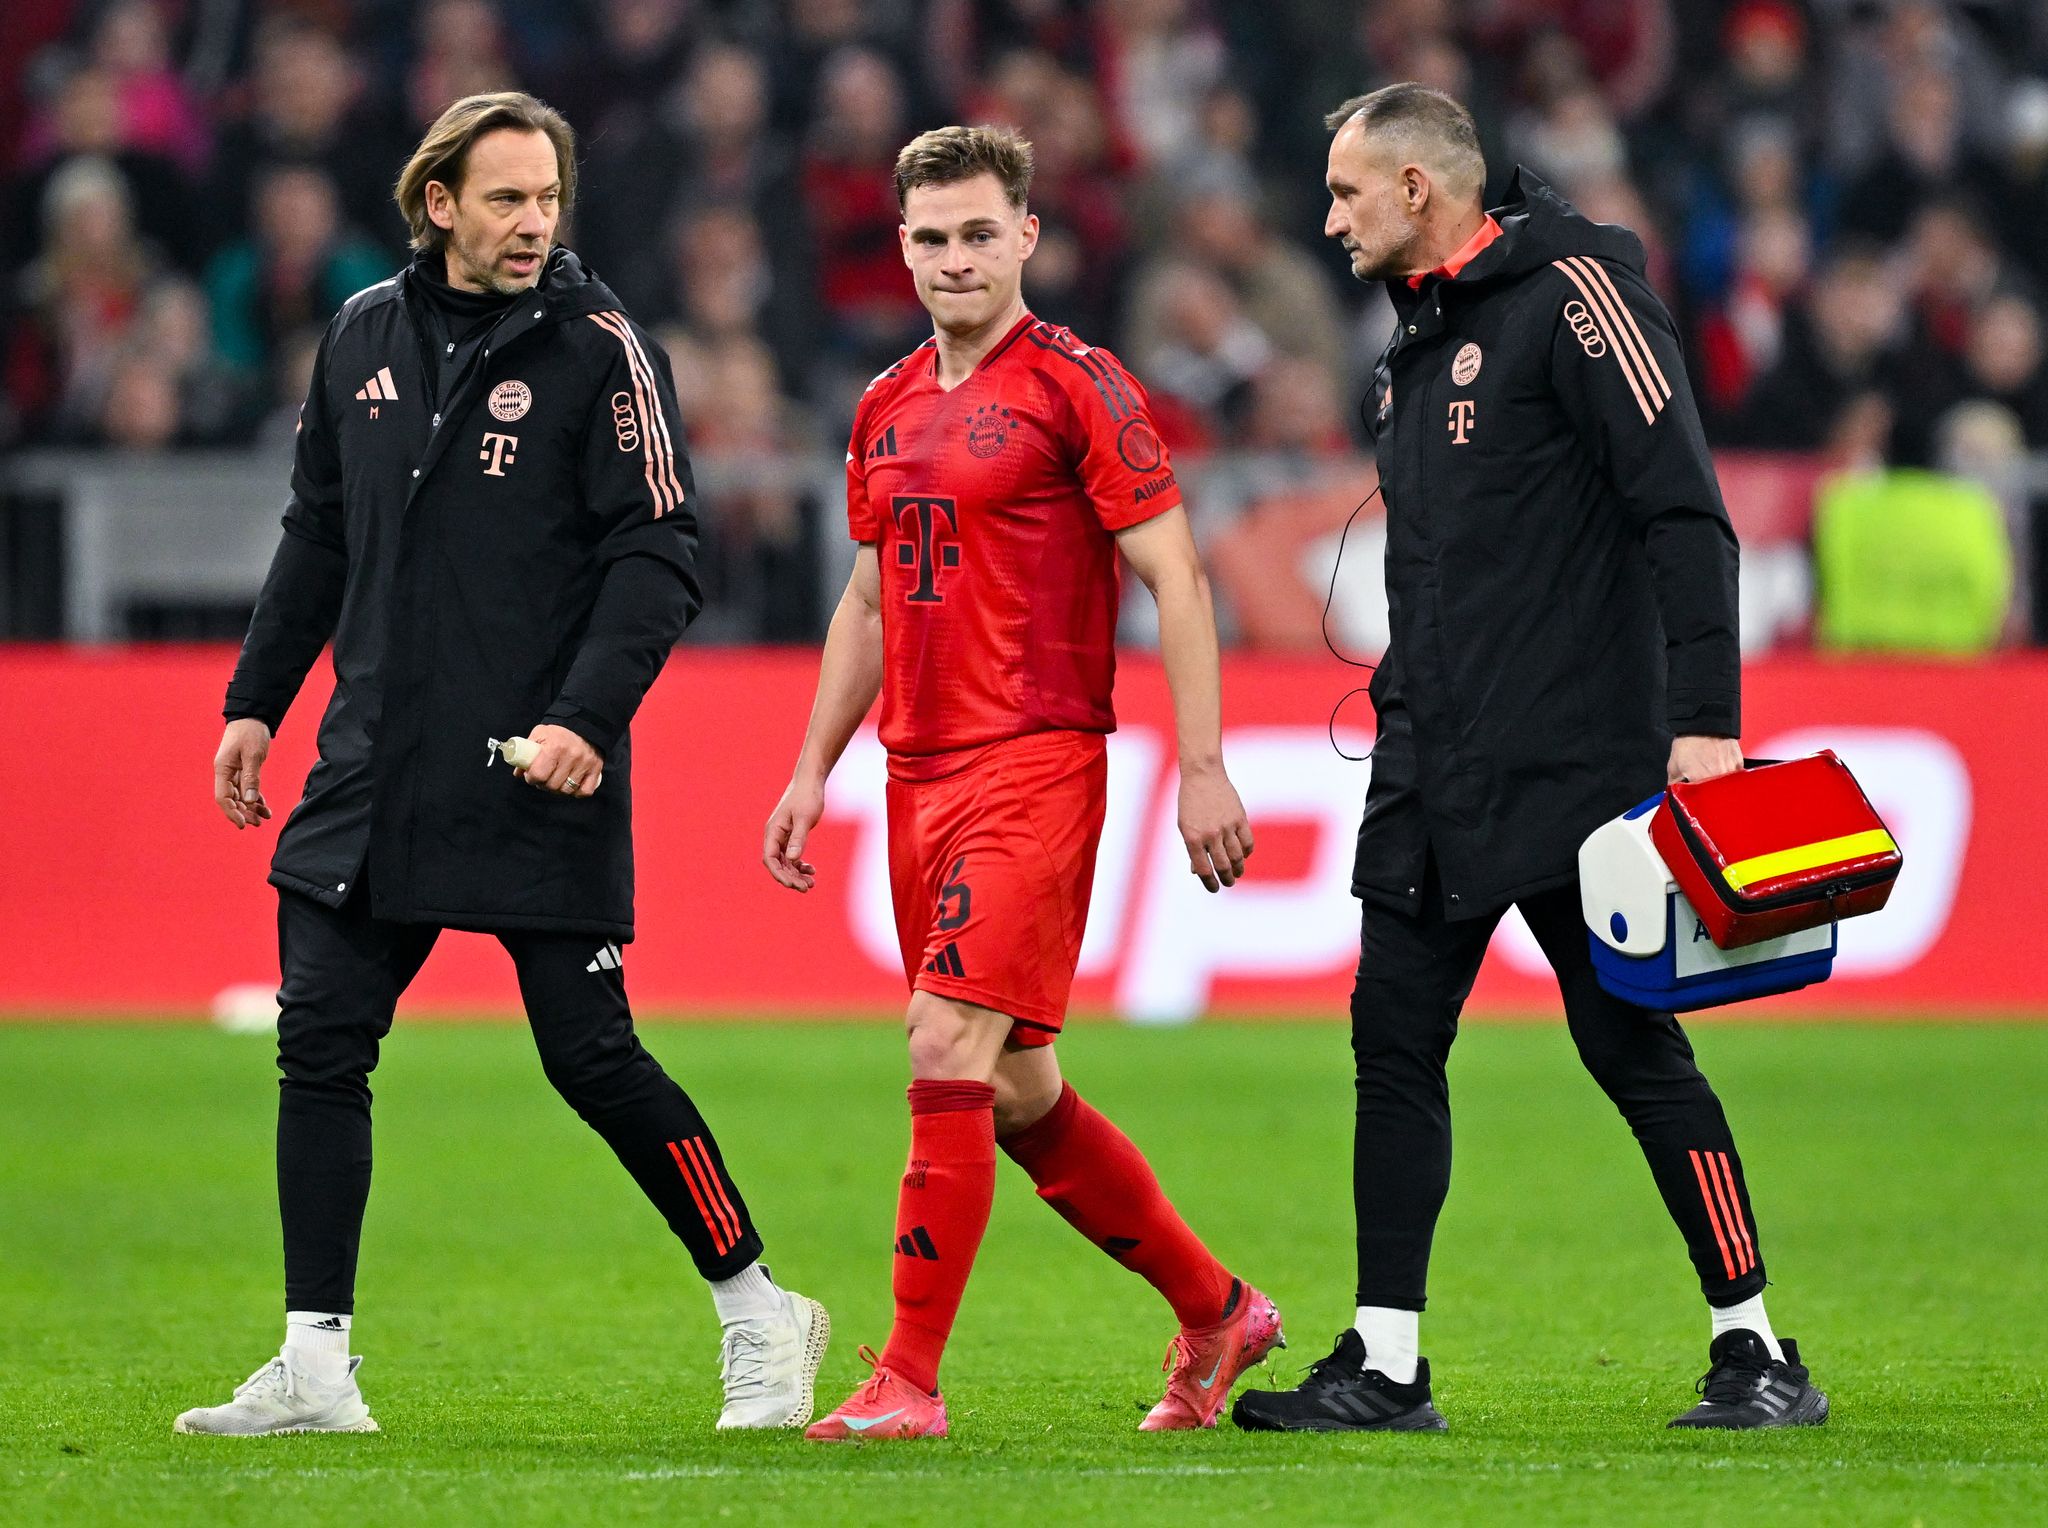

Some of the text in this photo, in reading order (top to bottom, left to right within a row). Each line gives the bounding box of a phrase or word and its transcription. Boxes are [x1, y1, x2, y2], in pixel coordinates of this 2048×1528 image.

[506, 383, 529, 401] BAYERN
[370, 406, 379, 420] M
[938, 856, 971, 931] 6
